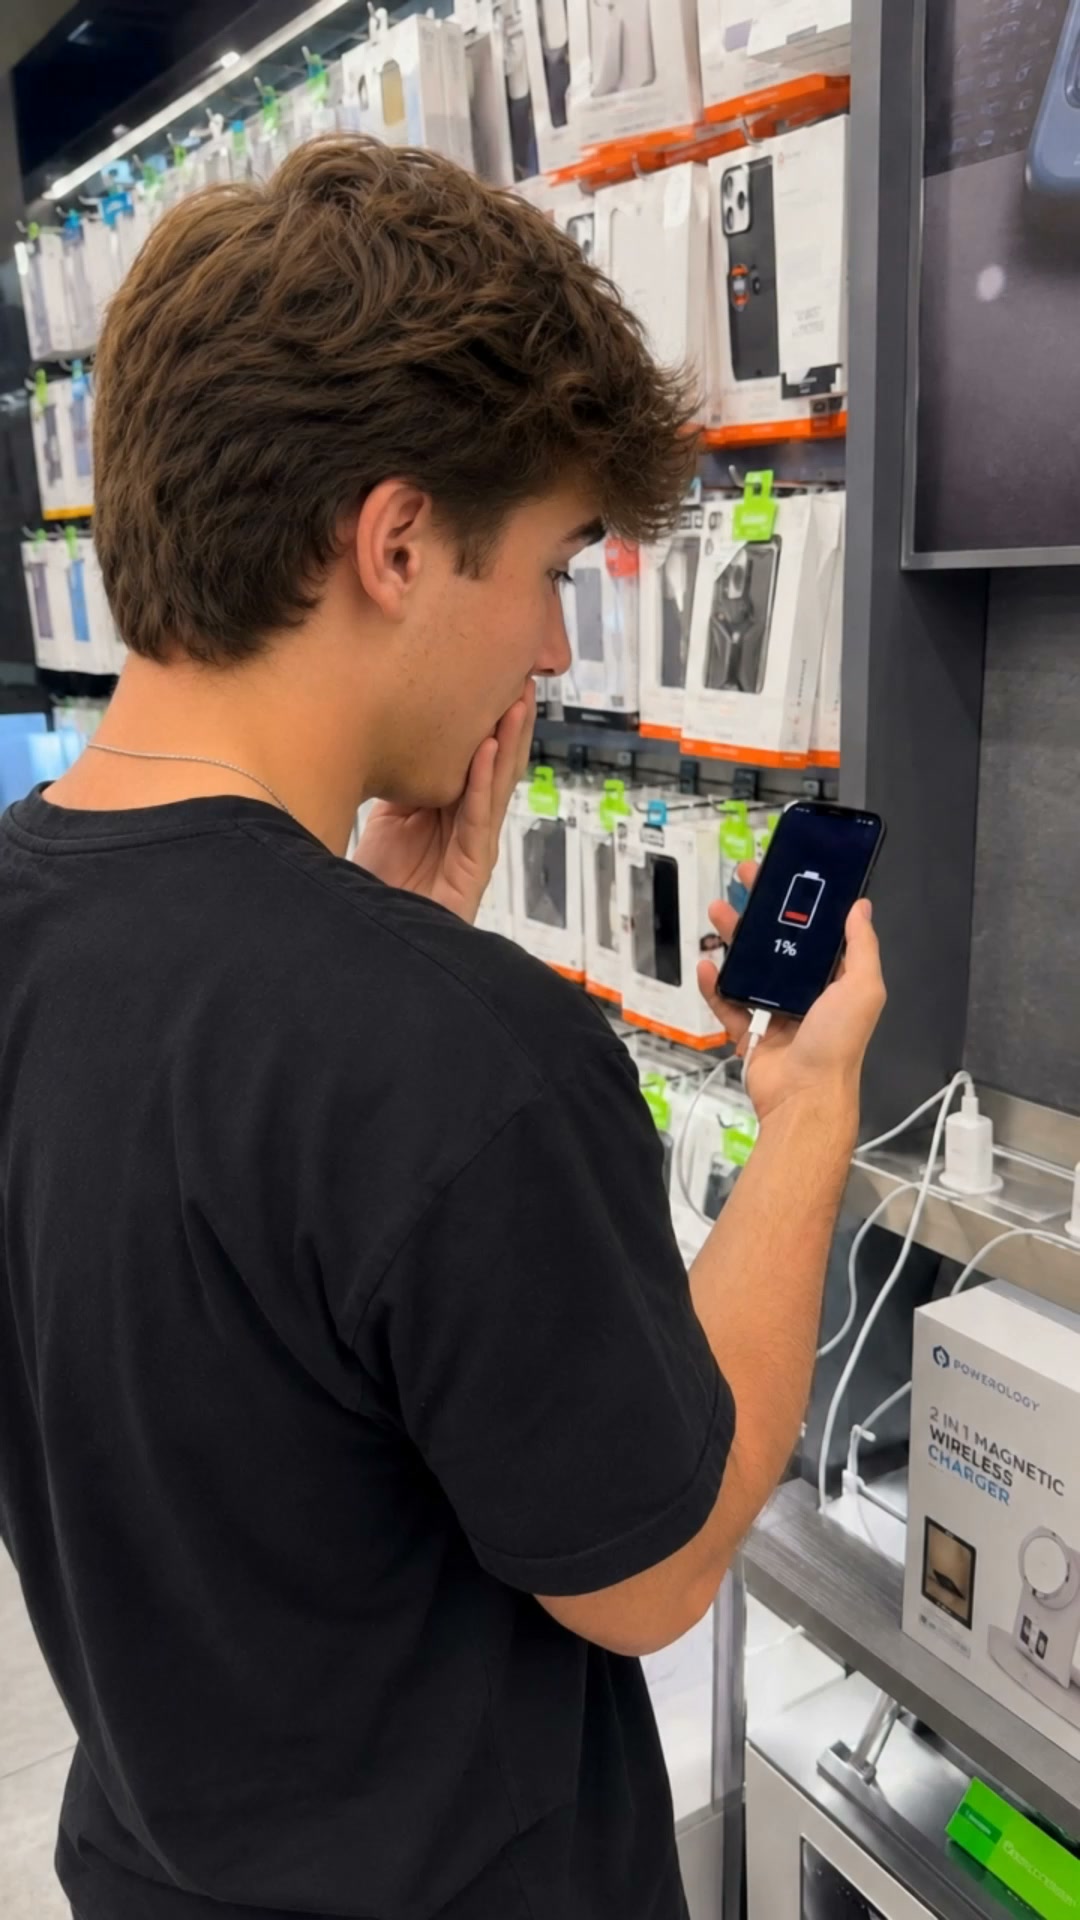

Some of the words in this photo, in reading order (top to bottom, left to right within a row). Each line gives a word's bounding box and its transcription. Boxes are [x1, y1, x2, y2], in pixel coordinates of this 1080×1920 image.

[774, 938, 798, 957] 1%
[953, 1359, 1040, 1412] POWEROLOGY
[928, 1444, 1011, 1506] CHARGER
[929, 1406, 939, 1422] 2
[943, 1413, 959, 1434] IN
[962, 1424, 969, 1441] 1
[974, 1431, 1065, 1497] MAGNETIC
[929, 1424, 1014, 1487] WIRELESS
